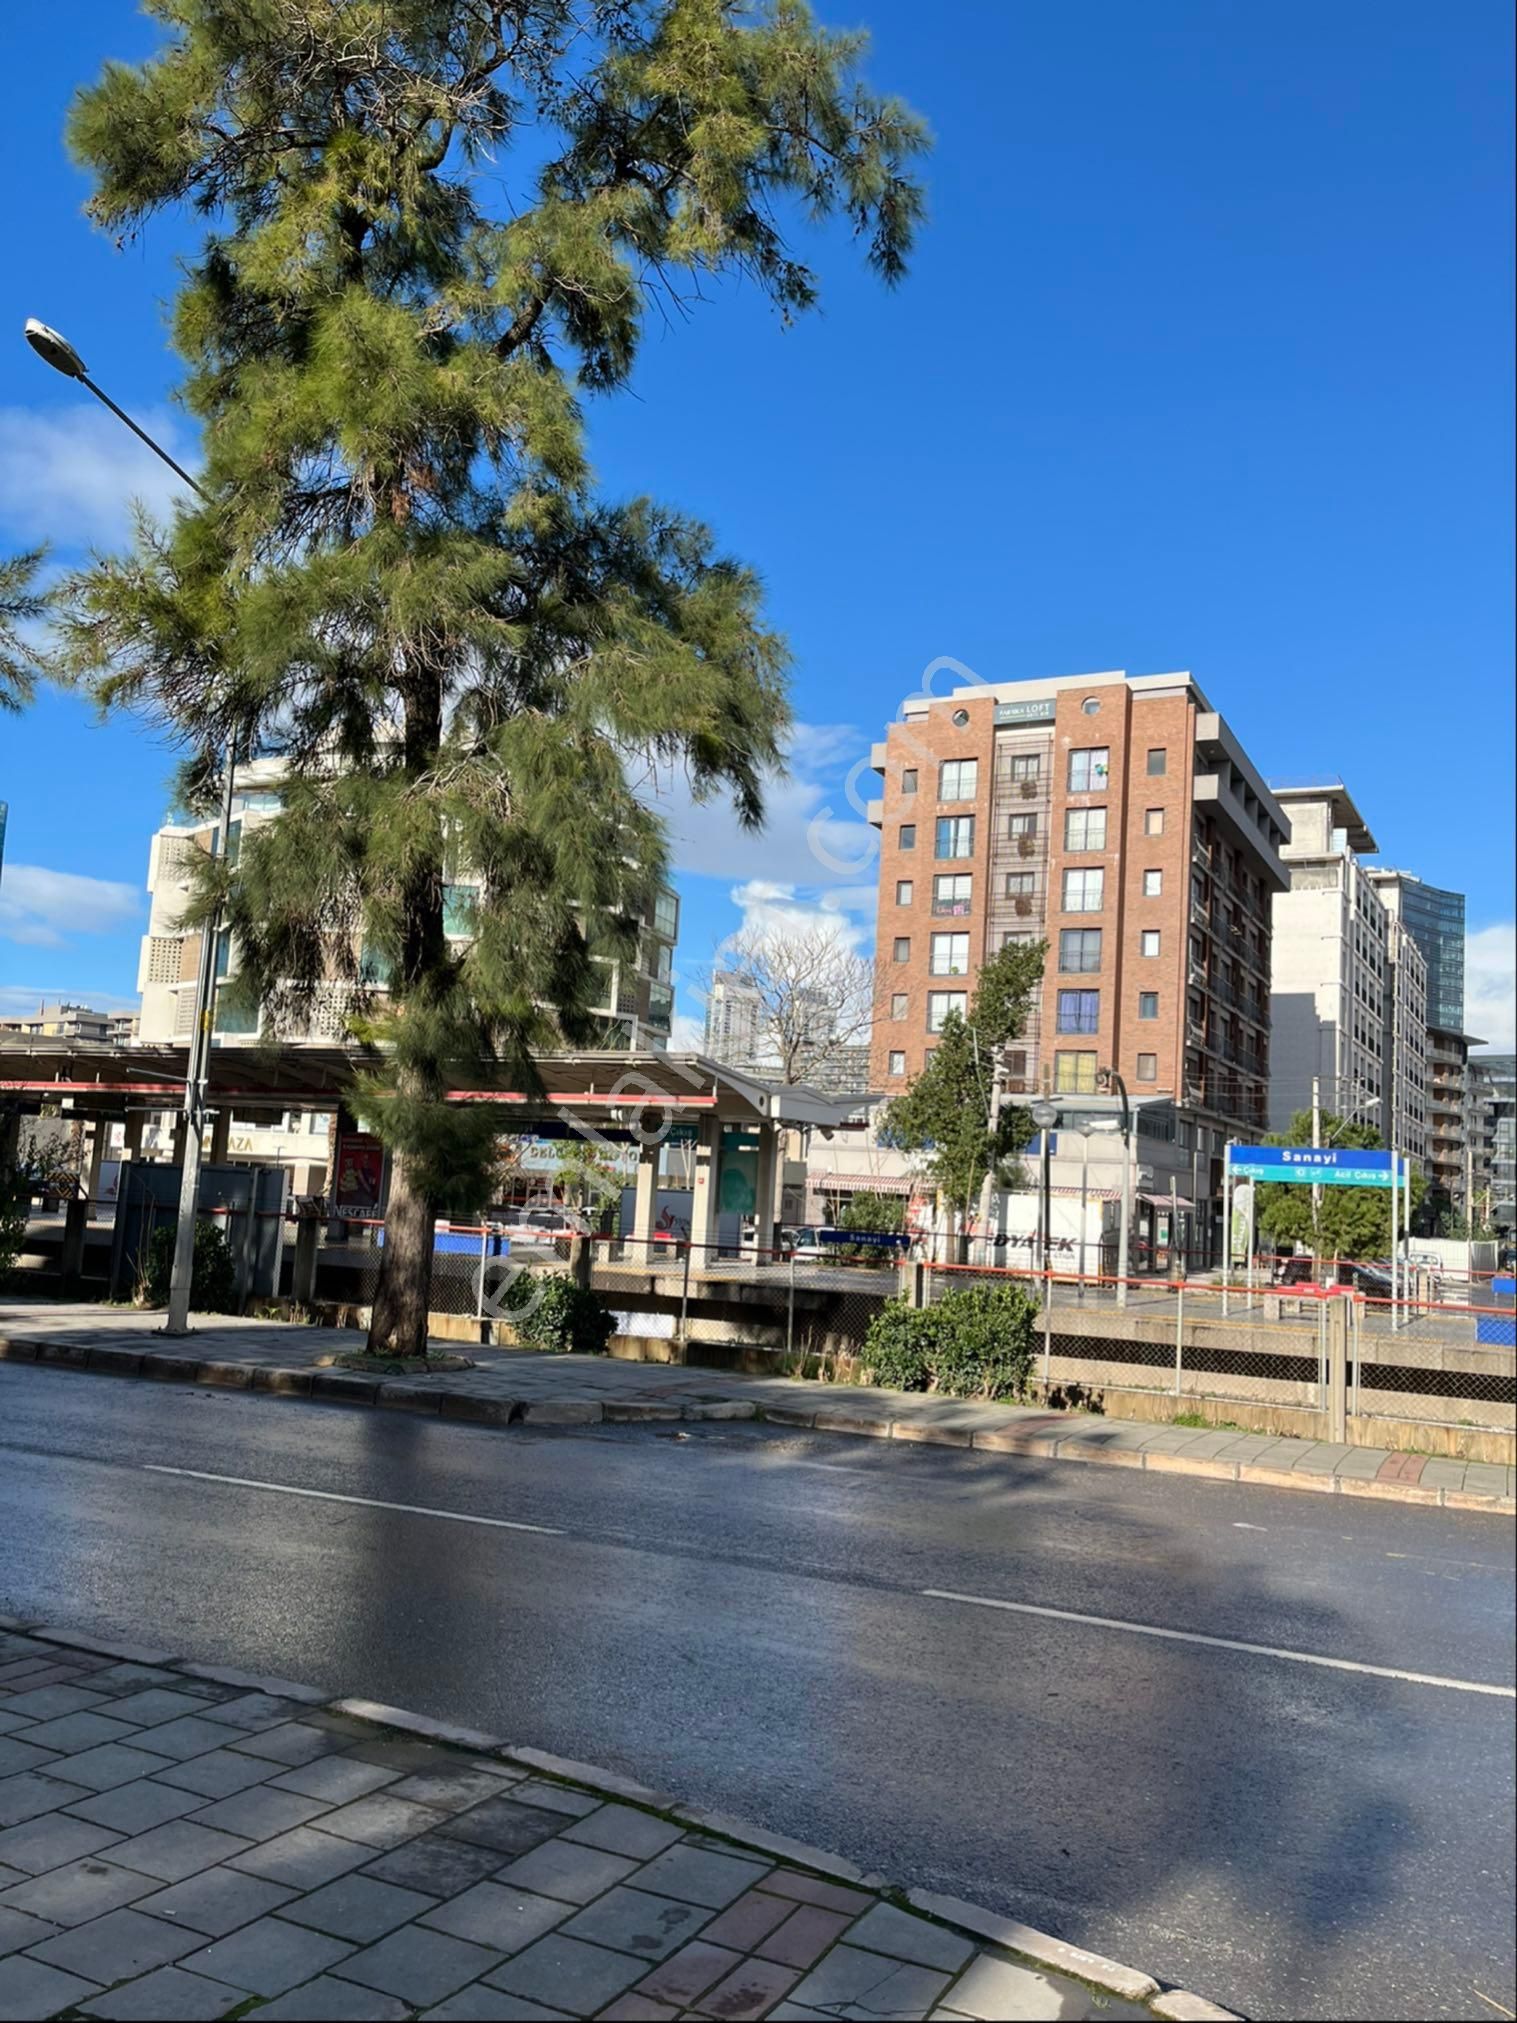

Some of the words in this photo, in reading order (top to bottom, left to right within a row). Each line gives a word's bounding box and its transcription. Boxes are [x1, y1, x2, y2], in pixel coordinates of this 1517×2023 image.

[1026, 703, 1050, 713] LOFT
[1282, 1150, 1337, 1164] Sanayi
[849, 1233, 881, 1244] Sanayi
